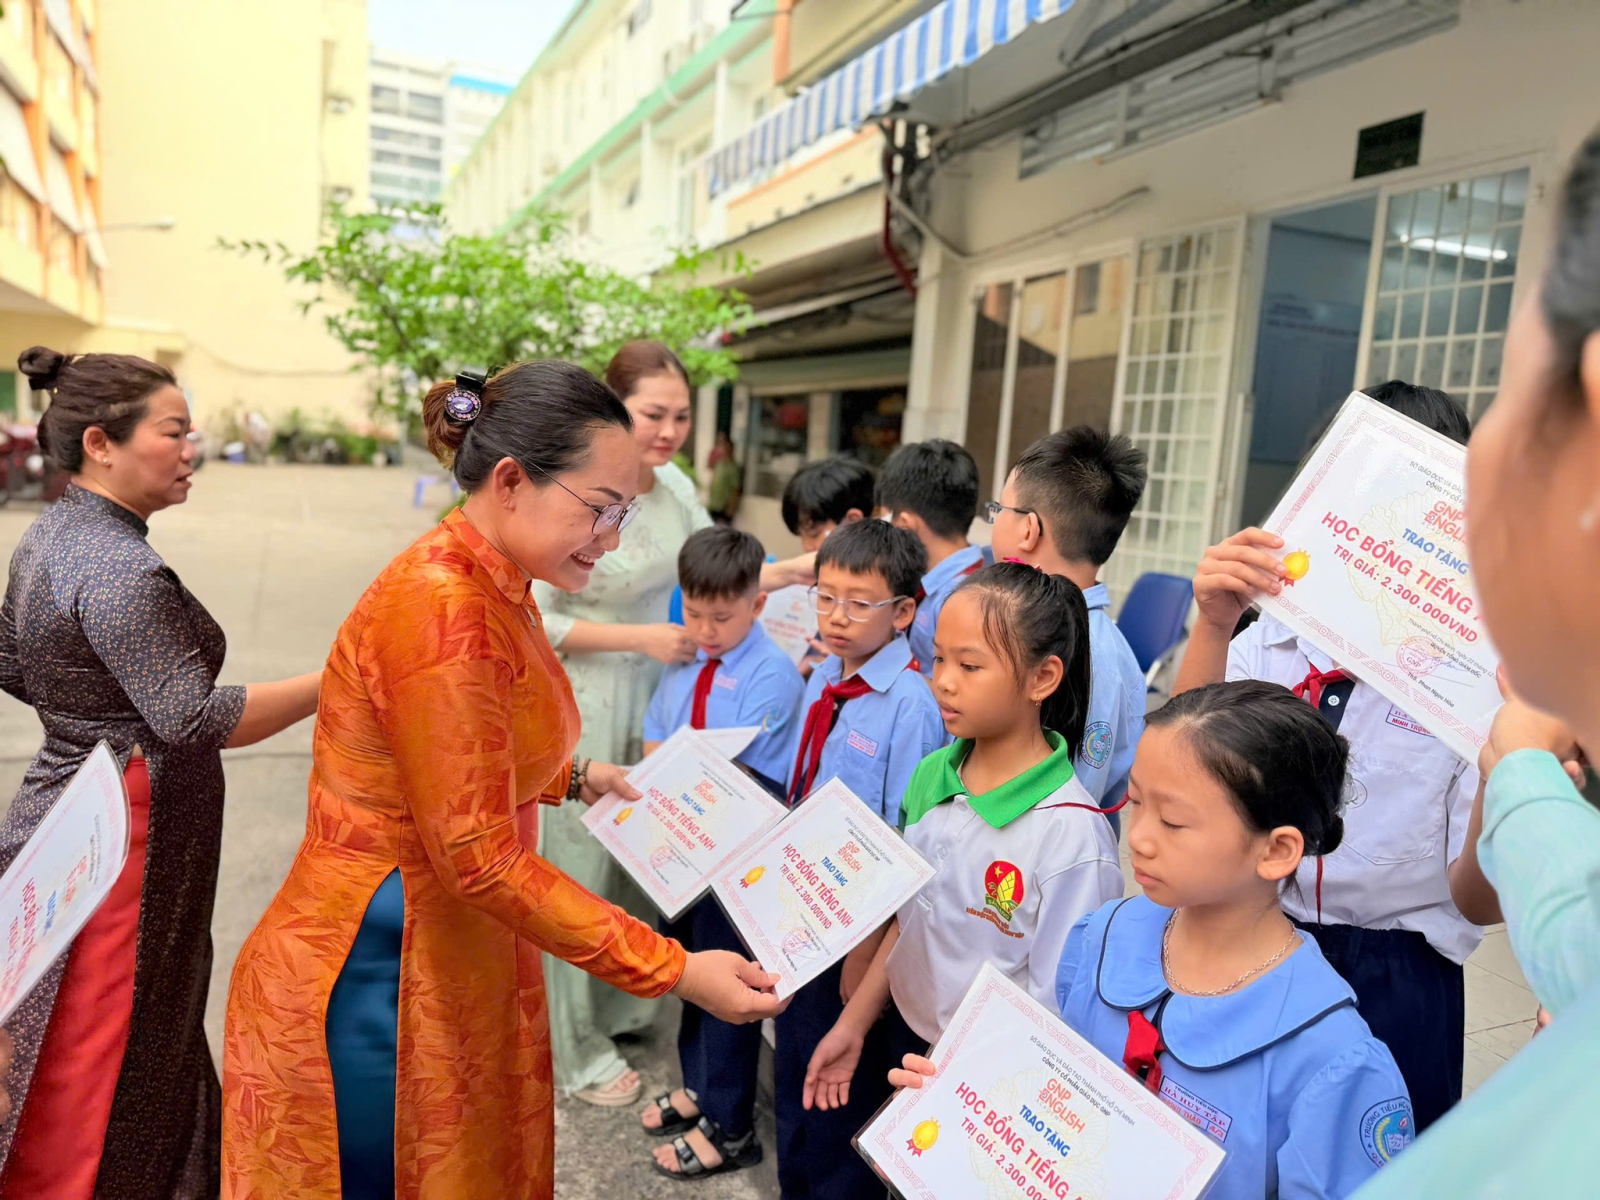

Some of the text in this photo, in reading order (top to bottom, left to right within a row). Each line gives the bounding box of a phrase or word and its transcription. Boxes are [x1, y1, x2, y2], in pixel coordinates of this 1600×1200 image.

[1417, 465, 1431, 476] GIÁO
[1426, 480, 1443, 492] CÔNG
[1442, 489, 1451, 497] TY
[1423, 510, 1467, 543] ENGLI
[1433, 500, 1466, 522] GNP
[1321, 511, 1473, 615] HỌC BỔNG TIẾNG
[1402, 528, 1470, 575] TRAO TẶNG
[1333, 544, 1354, 565] TRỊ
[1353, 558, 1380, 581] GIÁ:
[1380, 576, 1478, 643] 2.300.000VND
[1418, 679, 1432, 691] Phan
[1431, 688, 1444, 700] Ngọc
[1444, 698, 1455, 707] Hòa
[1392, 718, 1408, 727] MINH
[647, 786, 716, 851] HỌC BỔNG TIẾNG ANH
[837, 846, 862, 872] ENGLISH
[845, 840, 860, 854] GNP
[782, 843, 800, 863] HỌC
[795, 859, 820, 886] BỔNG
[815, 882, 840, 911] TIẾNG
[834, 908, 854, 928] ANH
[820, 856, 836, 873] TRAO
[832, 870, 848, 887] TẶNG
[780, 863, 790, 877] TRỊ
[786, 873, 800, 887] GIÁ:
[796, 885, 832, 929] 2.300.000VND
[1030, 1035, 1037, 1043] SỞ
[1036, 1040, 1047, 1052] GIÁO
[1046, 1049, 1056, 1060] DỤC
[1055, 1057, 1063, 1065] VÀ
[1062, 1060, 1073, 1073] ĐÀO
[1081, 1077, 1098, 1094] THÀNH
[1096, 1090, 1108, 1102] PHỐ
[1105, 1098, 1115, 1108] HỒ
[1113, 1104, 1123, 1116] CHÍ
[1121, 1112, 1135, 1126] MINH
[1041, 1056, 1111, 1117] CÔNG TY CỔ PHẦN GIÁO DỤC GNP
[1046, 1077, 1072, 1100] GNP
[1038, 1087, 1086, 1134] ENGLISH
[1164, 1086, 1177, 1099] HÀ
[1179, 1096, 1201, 1112] HUY
[1204, 1110, 1226, 1126] TẬP
[1380, 1102, 1397, 1114] TIỂU
[955, 1081, 1070, 1200] HỌC BỔNG TIẾNG
[960, 1116, 978, 1139] TRỊ
[975, 1132, 997, 1158] GIÁ:
[1019, 1104, 1071, 1158] TRAO TẶNG
[1210, 1125, 1224, 1138] 4/3
